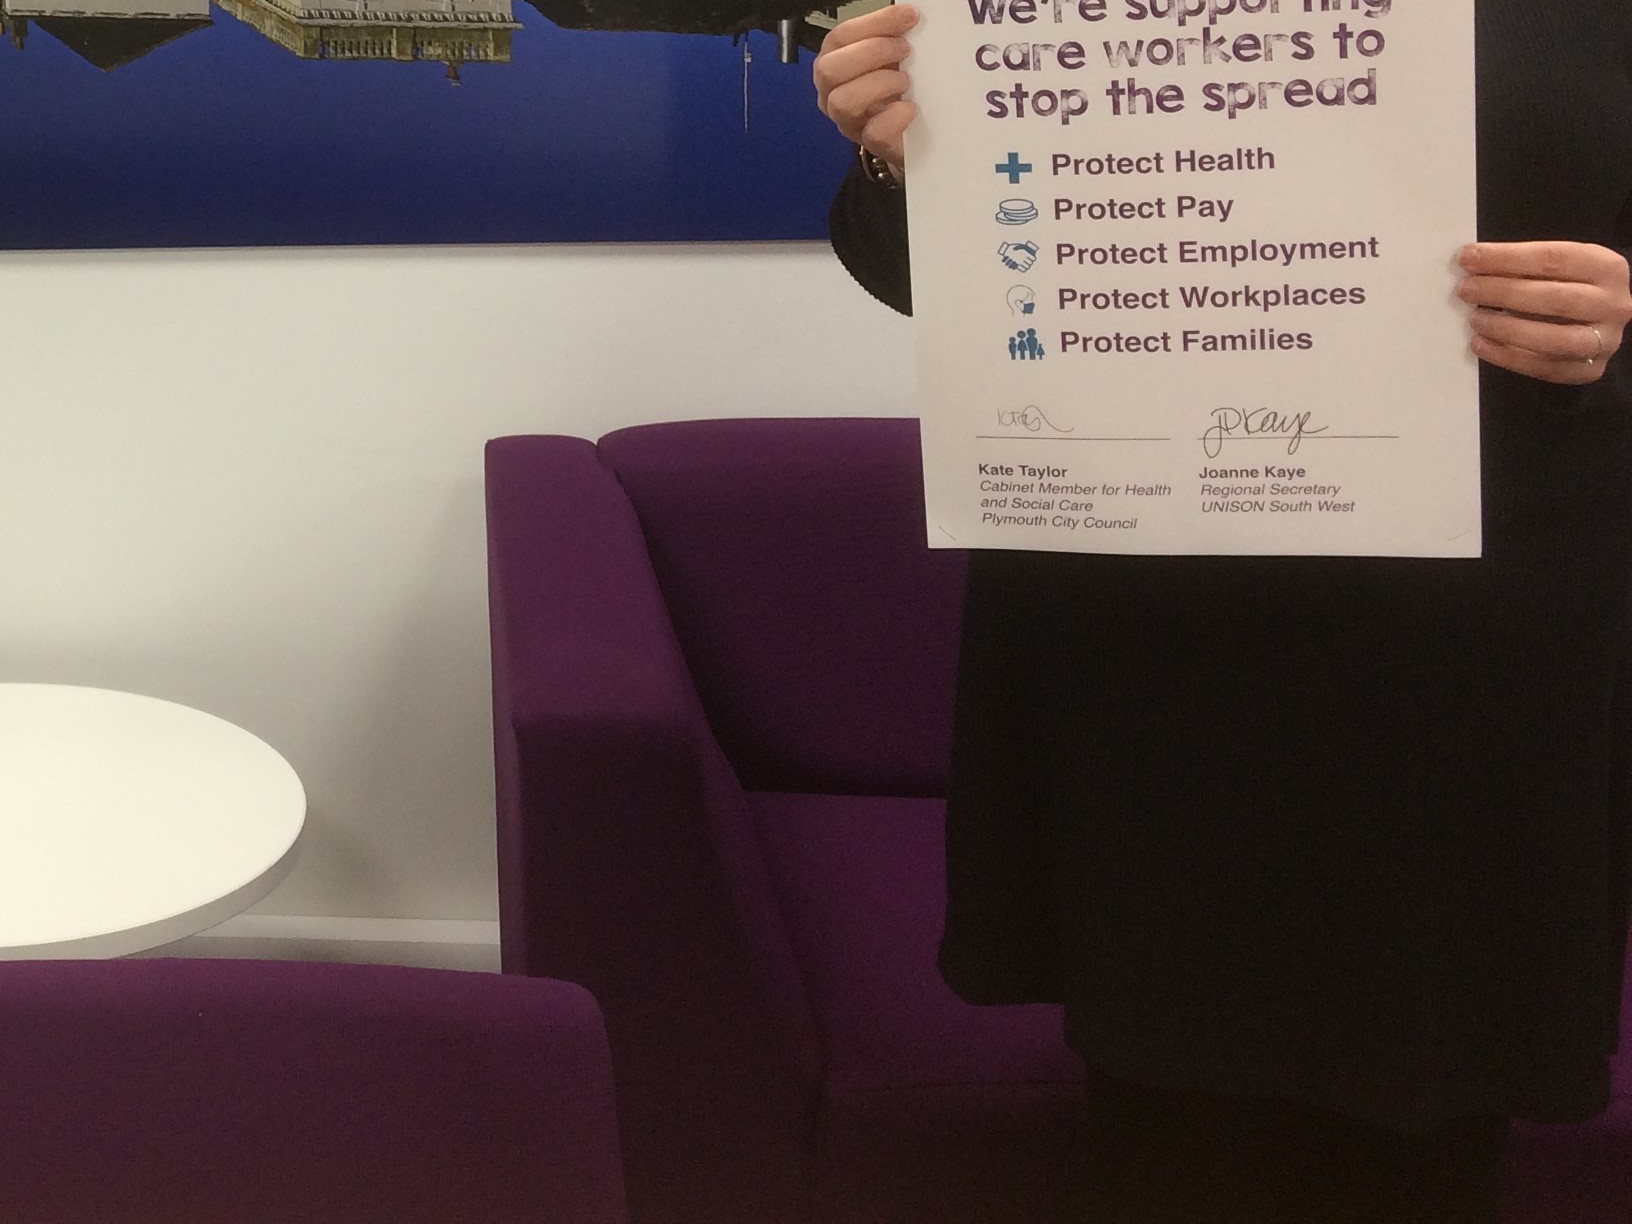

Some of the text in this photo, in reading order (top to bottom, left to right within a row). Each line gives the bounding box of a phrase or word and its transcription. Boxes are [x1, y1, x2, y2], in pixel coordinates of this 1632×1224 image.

[975, 22, 1386, 72] care workers to
[985, 67, 1377, 126] stop the spread
[1051, 147, 1275, 176] Protect Health
[1054, 195, 1234, 223] Protect Pay
[1056, 236, 1380, 268] Protect Employment
[1058, 283, 1366, 313] Protect Workplaces
[1060, 328, 1313, 353] Protect Families
[978, 463, 1068, 481] Kate Taylor
[1198, 466, 1306, 481] Joanne Kaye
[980, 479, 1172, 496] Cabinet Member for Health
[1200, 483, 1341, 498] Regional Secretary
[980, 497, 1094, 512] and Social Care
[1201, 500, 1355, 513] UNISON South West
[982, 512, 1138, 531] Plymouth City Council
